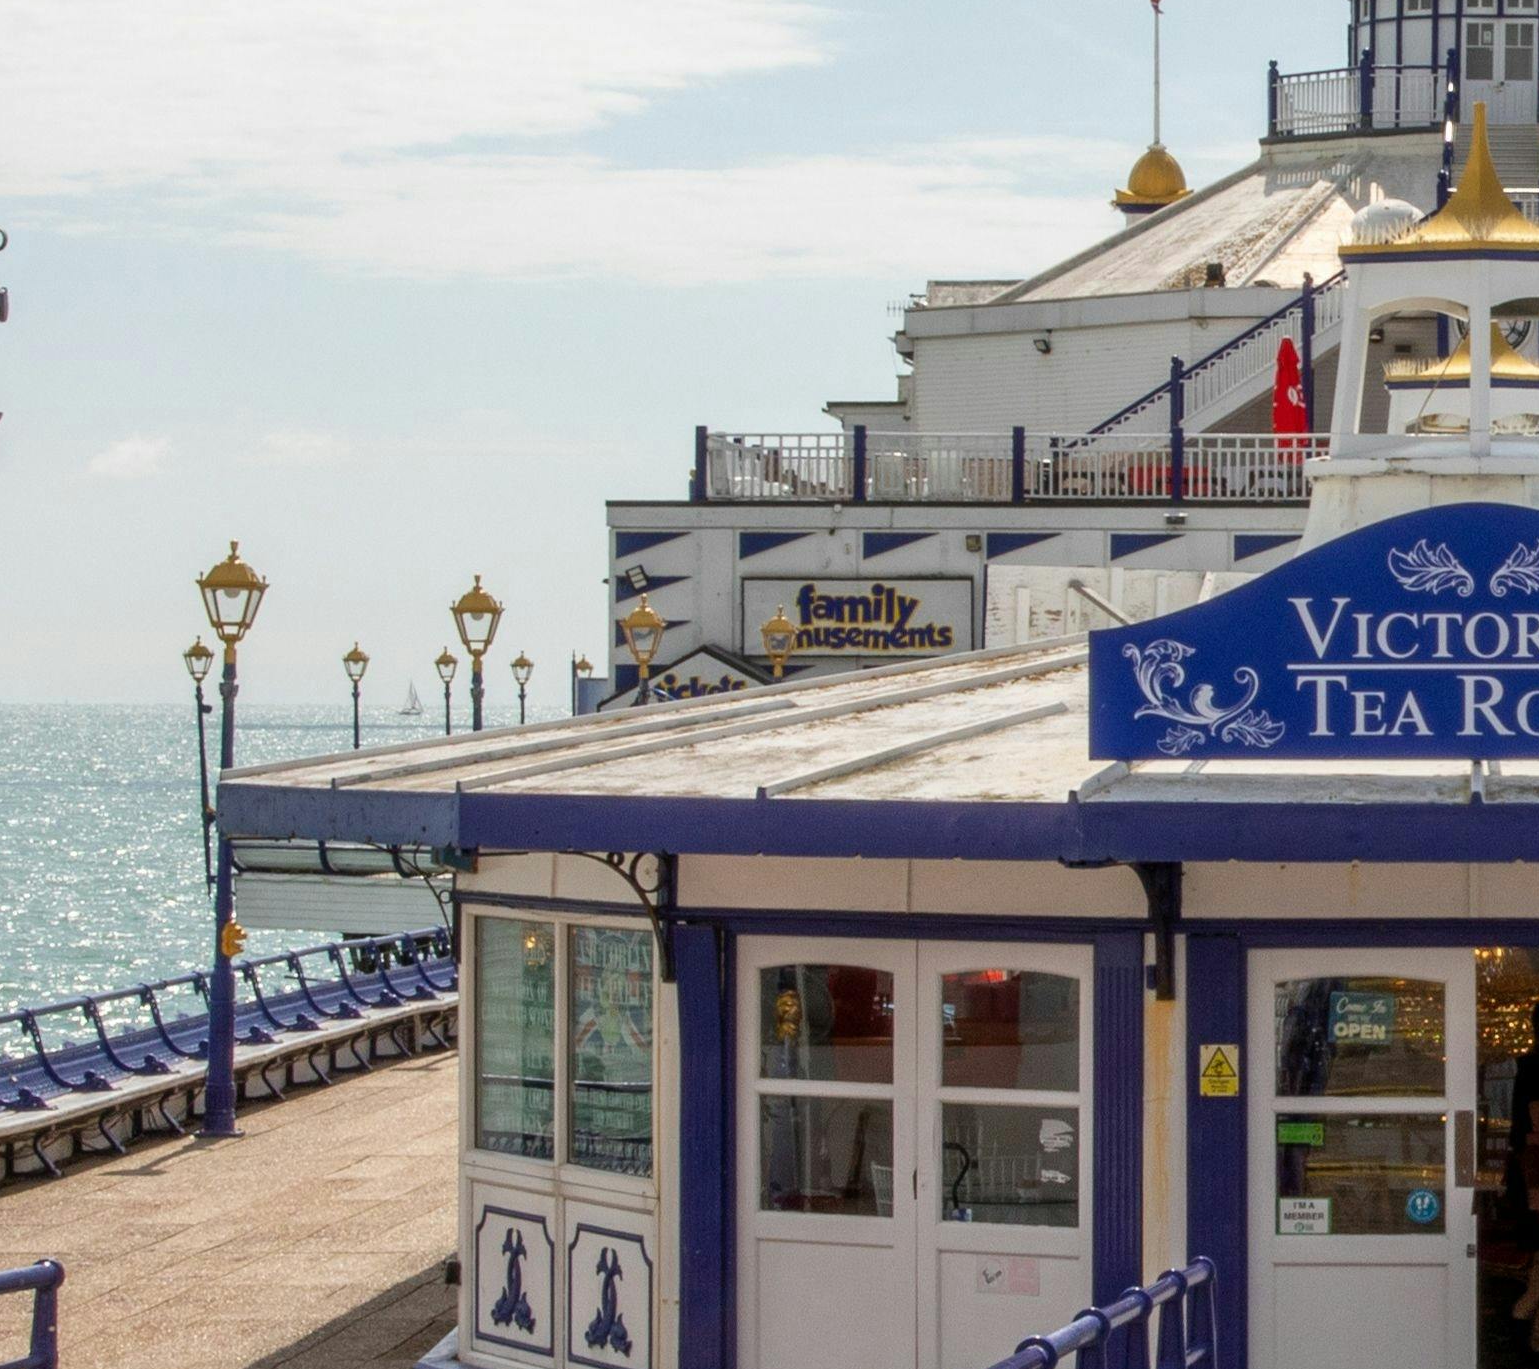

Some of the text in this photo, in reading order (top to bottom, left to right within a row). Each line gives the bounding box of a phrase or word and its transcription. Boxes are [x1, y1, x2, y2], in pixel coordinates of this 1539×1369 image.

[796, 583, 920, 629] family
[793, 622, 954, 652] musements
[1295, 675, 1433, 737] TEA
[1334, 1022, 1386, 1040] OPEN
[1284, 1212, 1325, 1220] MEMBER
[1293, 1201, 1315, 1209] I'M A
